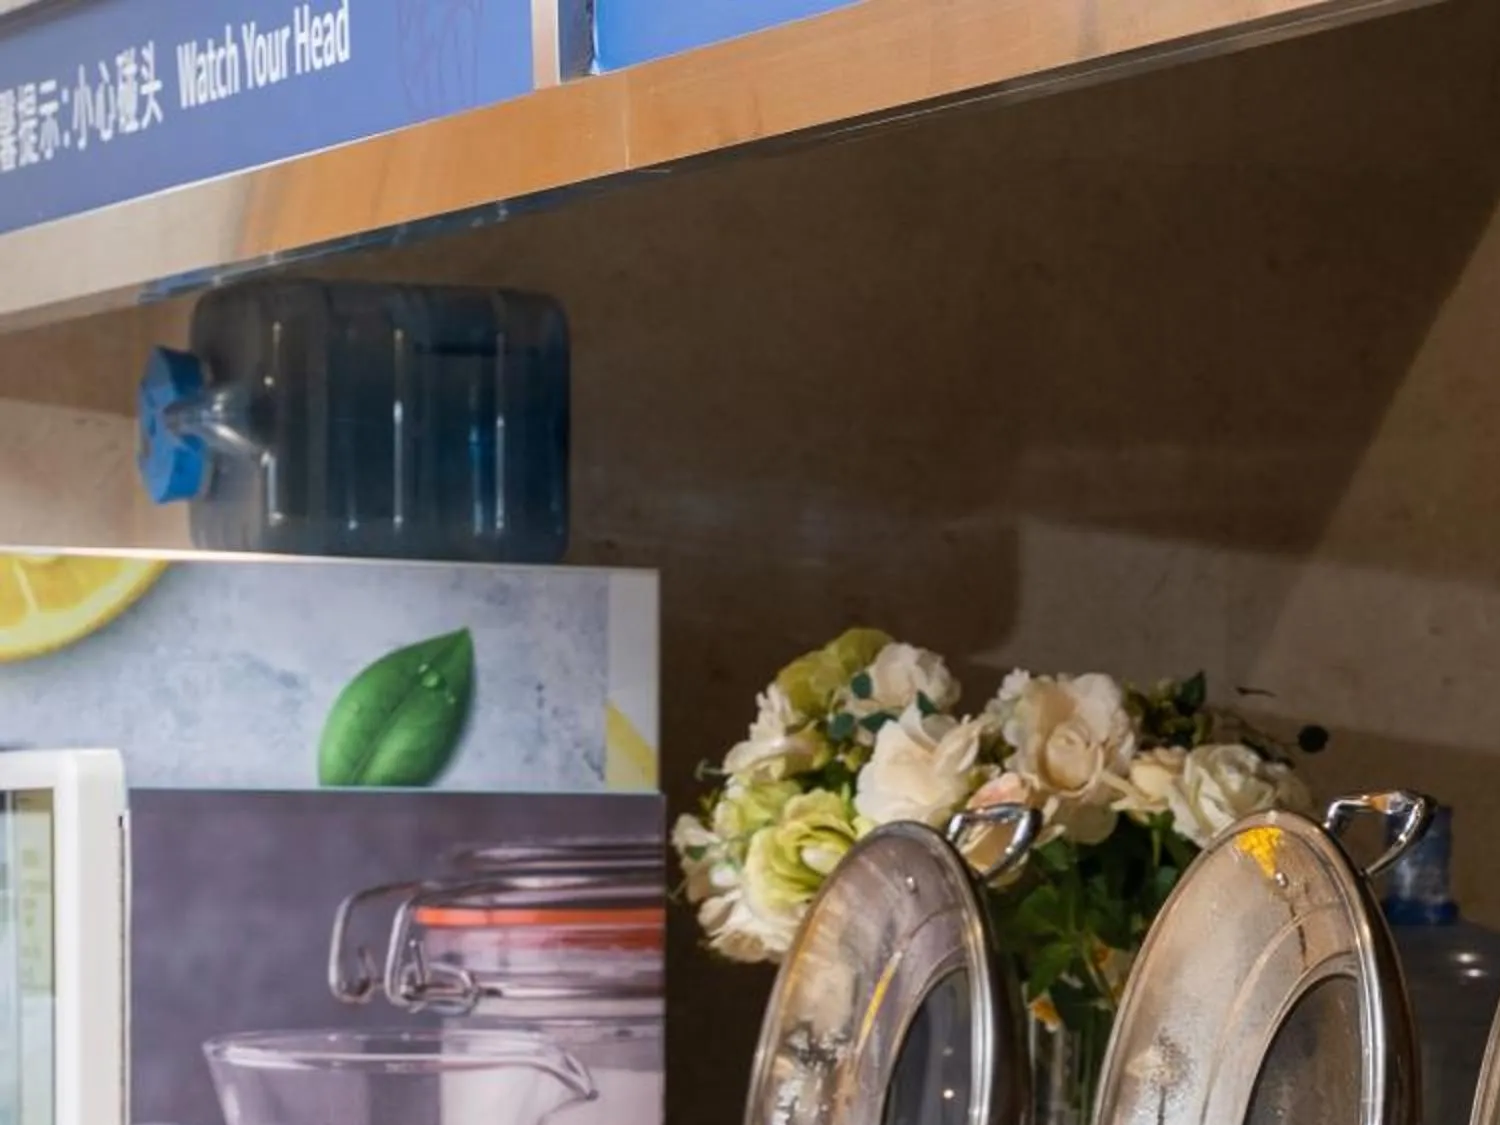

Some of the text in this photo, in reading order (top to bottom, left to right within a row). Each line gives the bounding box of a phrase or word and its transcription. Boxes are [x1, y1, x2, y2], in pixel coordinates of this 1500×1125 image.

[177, 0, 350, 109] Watch Your Head
